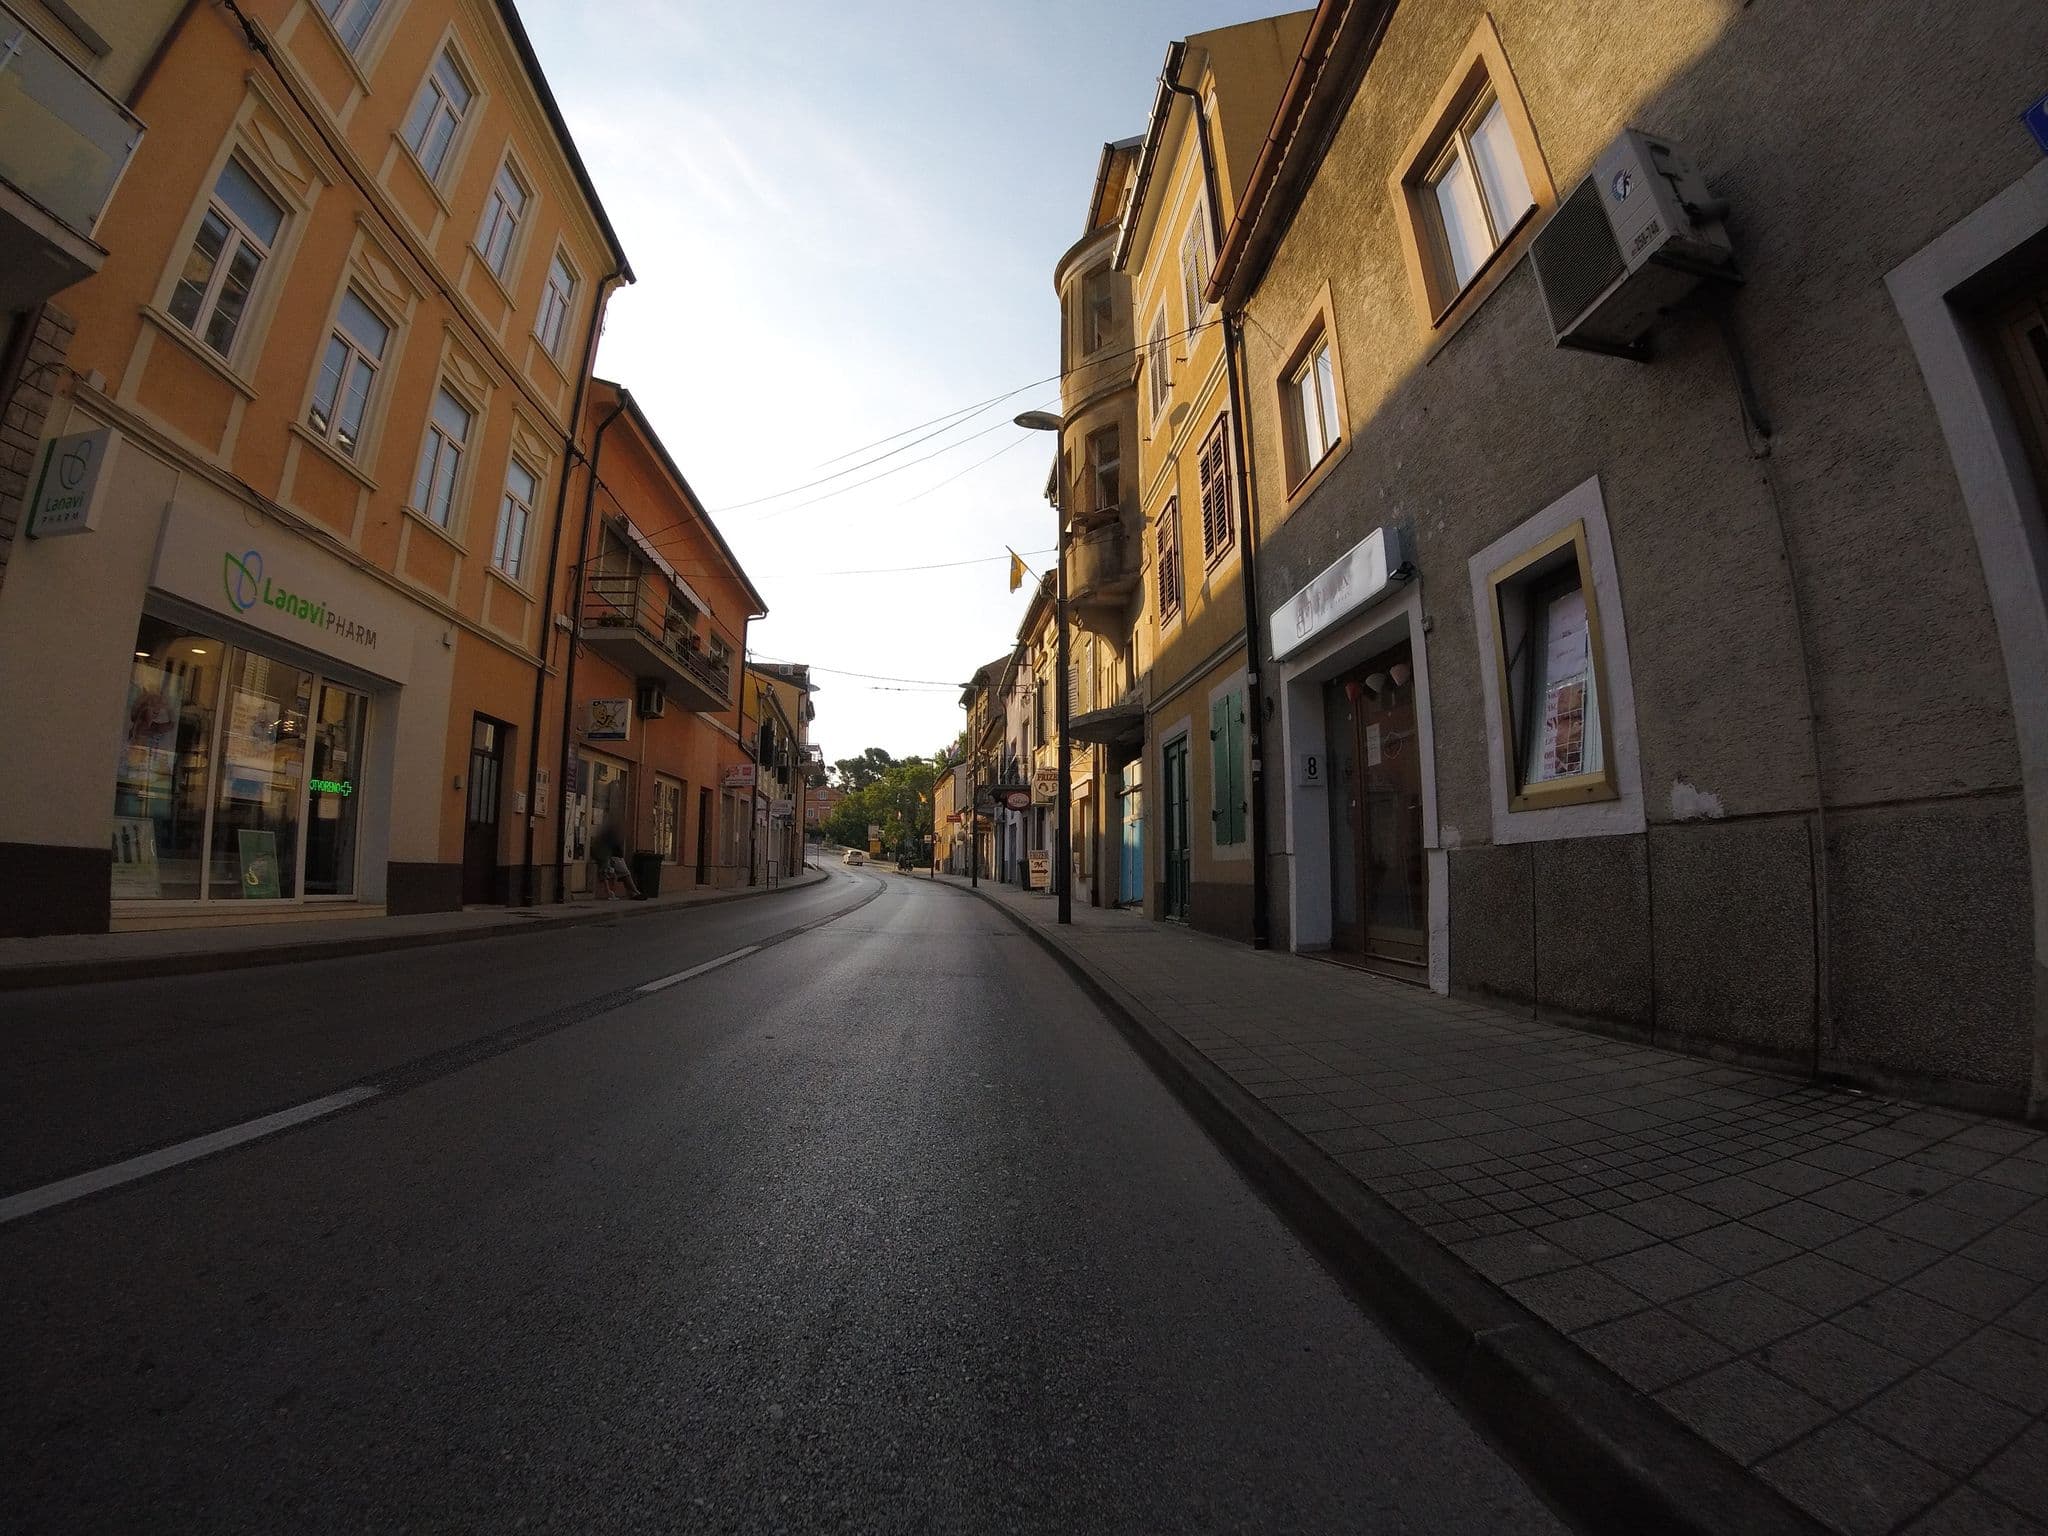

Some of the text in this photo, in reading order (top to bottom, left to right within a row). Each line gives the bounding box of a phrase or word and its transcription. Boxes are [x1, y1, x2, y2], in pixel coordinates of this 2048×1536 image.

[46, 492, 84, 512] Lanavi
[263, 577, 377, 650] Lanavi PHARM
[1308, 756, 1317, 776] 8
[309, 779, 341, 794] OTVORENO
[1036, 773, 1058, 782] FRIZE
